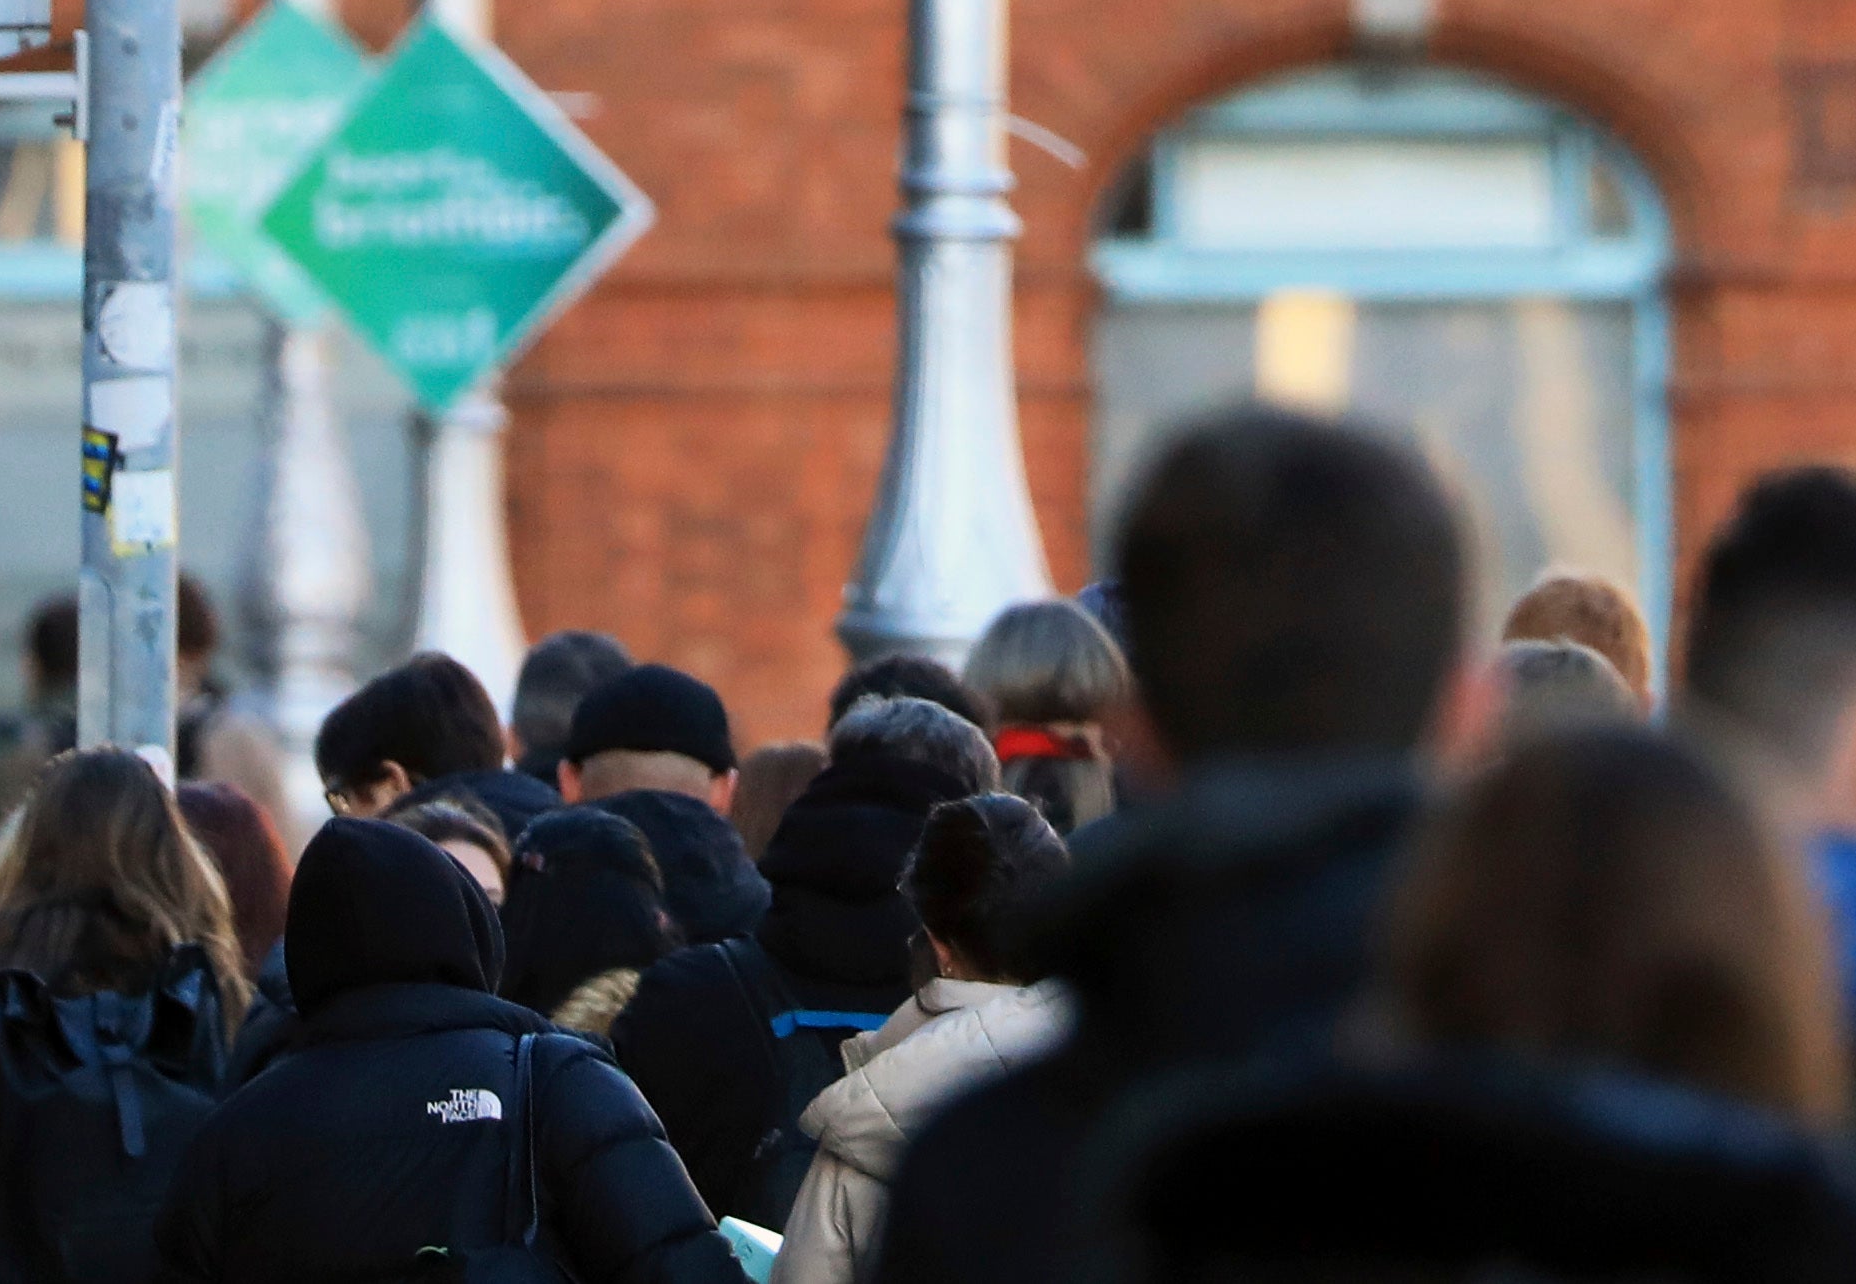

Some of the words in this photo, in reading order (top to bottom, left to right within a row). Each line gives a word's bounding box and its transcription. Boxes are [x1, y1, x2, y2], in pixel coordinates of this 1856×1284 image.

[449, 1089, 478, 1101] THE
[427, 1099, 478, 1115] NORTH
[442, 1111, 477, 1123] FACE
